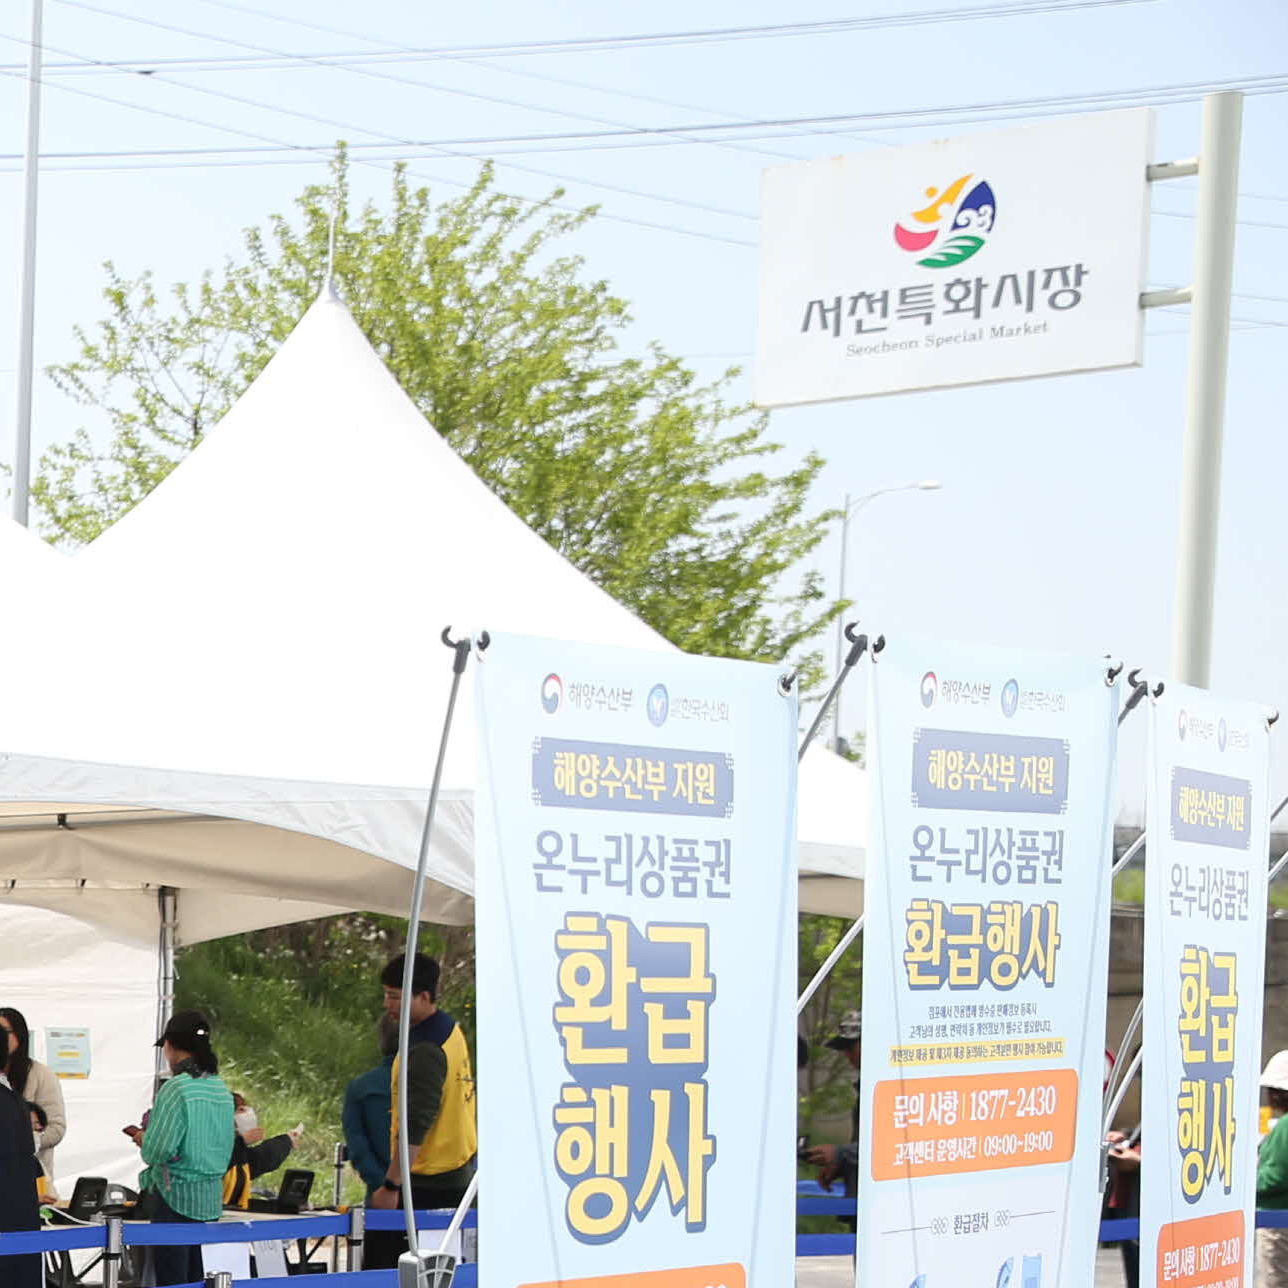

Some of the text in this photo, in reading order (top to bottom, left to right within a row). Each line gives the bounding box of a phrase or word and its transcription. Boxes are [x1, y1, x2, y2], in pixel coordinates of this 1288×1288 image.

[801, 263, 1089, 338] 서천특화시장
[847, 320, 1048, 357] Seocheon Special Market
[567, 682, 632, 713] 해양수산부
[553, 751, 715, 805] 해양수산부 지원
[928, 749, 1055, 795] 해양수산부 지원
[1179, 786, 1244, 831] 해양수산부 지원
[532, 830, 731, 899] 온누리상품권
[909, 825, 1064, 886] 온누리상품권
[1170, 863, 1249, 921] 온누리상품권
[903, 898, 1060, 989] 환급행사
[554, 913, 715, 1068] 환급
[1180, 945, 1238, 1065] 환급
[893, 1085, 1056, 1129] 문의 사항 1877-2430
[554, 1080, 715, 1239] 행사
[893, 1130, 1053, 1166] 고객센터 운영시간 09:00~19:00
[1178, 1077, 1236, 1200] 행사
[953, 1211, 989, 1235] 환급절차
[1163, 1235, 1239, 1281] 문의 사항 1877-2430
